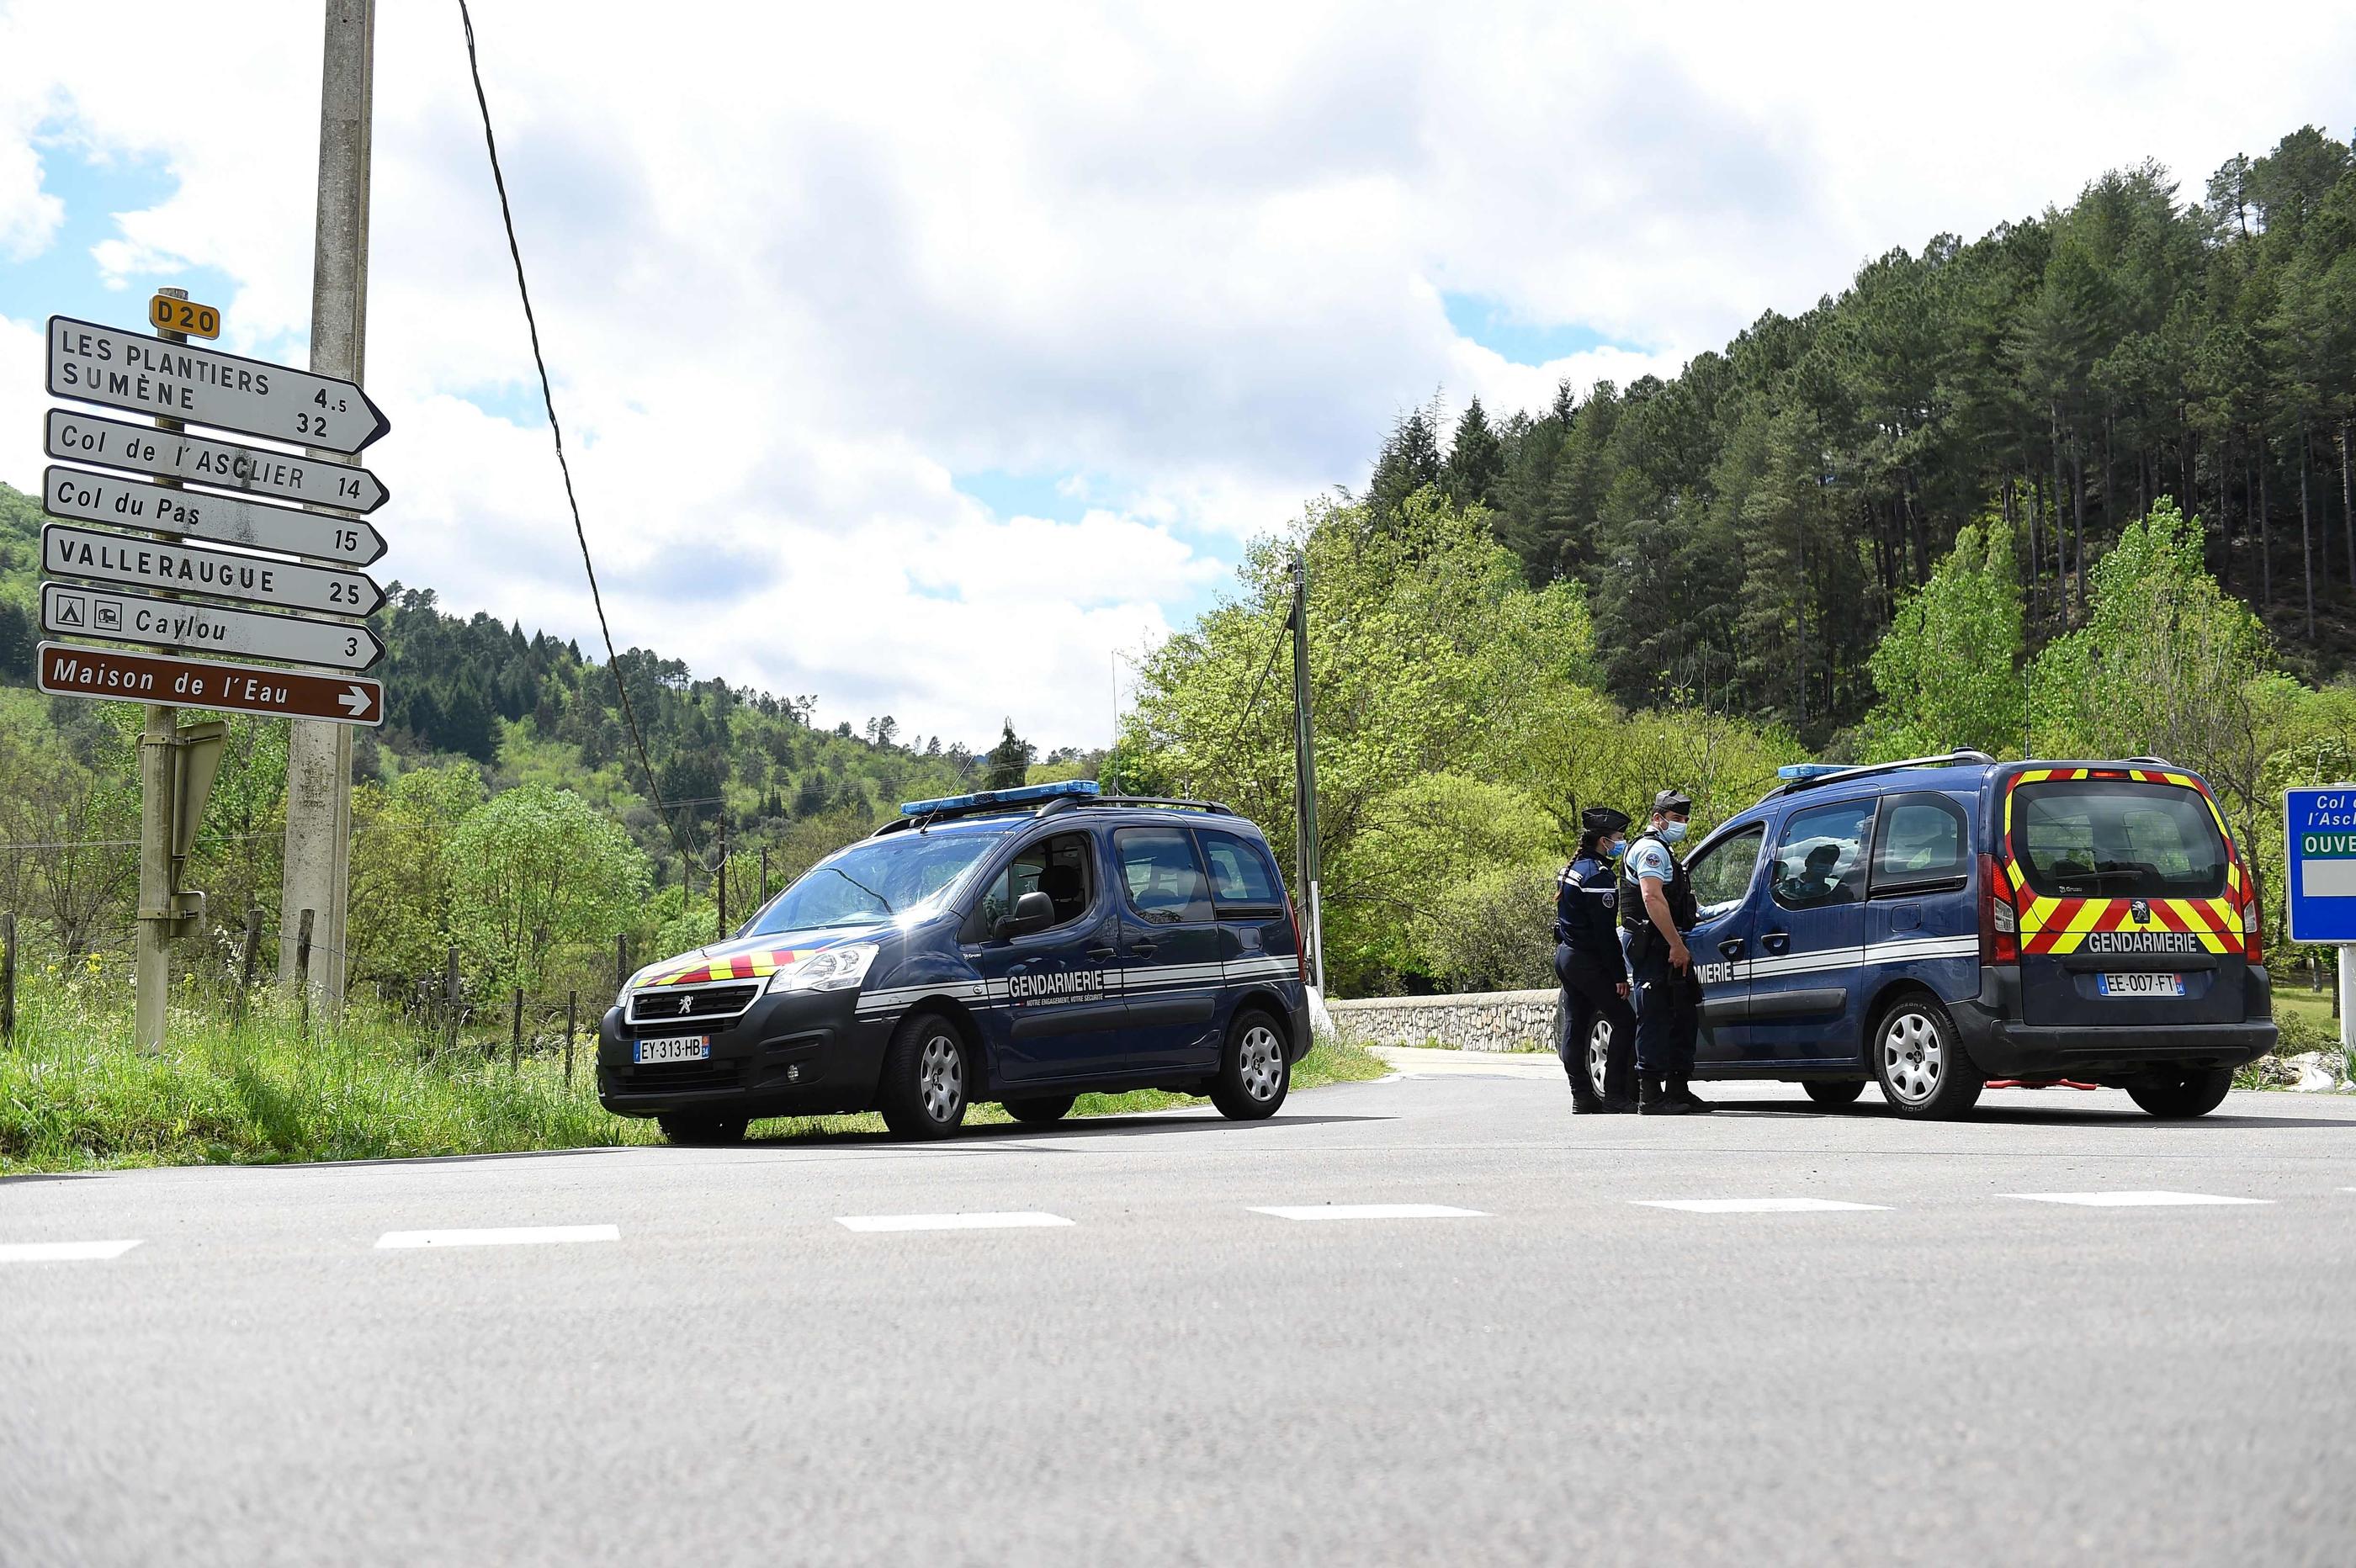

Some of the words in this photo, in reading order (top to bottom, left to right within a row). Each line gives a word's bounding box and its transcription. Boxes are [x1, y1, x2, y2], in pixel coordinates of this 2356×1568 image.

[158, 301, 172, 322] D
[180, 306, 215, 332] 20
[62, 331, 112, 361] LES
[126, 345, 269, 395] PLANTIERS
[62, 363, 194, 411] SUMÈNE
[296, 413, 327, 437] 32
[61, 425, 106, 453] Col
[126, 440, 156, 462] de
[337, 477, 361, 499] 14
[57, 482, 101, 509] Col
[114, 496, 142, 516] du
[157, 500, 200, 526] Pas
[334, 529, 358, 552] 15
[59, 539, 274, 592] VALLERAUGUE
[329, 581, 360, 605] 25
[135, 610, 227, 641] Caylou
[344, 637, 358, 657] 3
[52, 659, 154, 691] Maison
[174, 672, 204, 696] de
[2316, 795, 2345, 809] Col
[2088, 933, 2197, 953] GENDARMERIE
[1010, 970, 1102, 998] GENDARMERIE
[1084, 993, 1103, 1001] SÉCURITÉ
[2107, 975, 2173, 992] EE-007-FT
[641, 1039, 700, 1059] EY-313-HB
